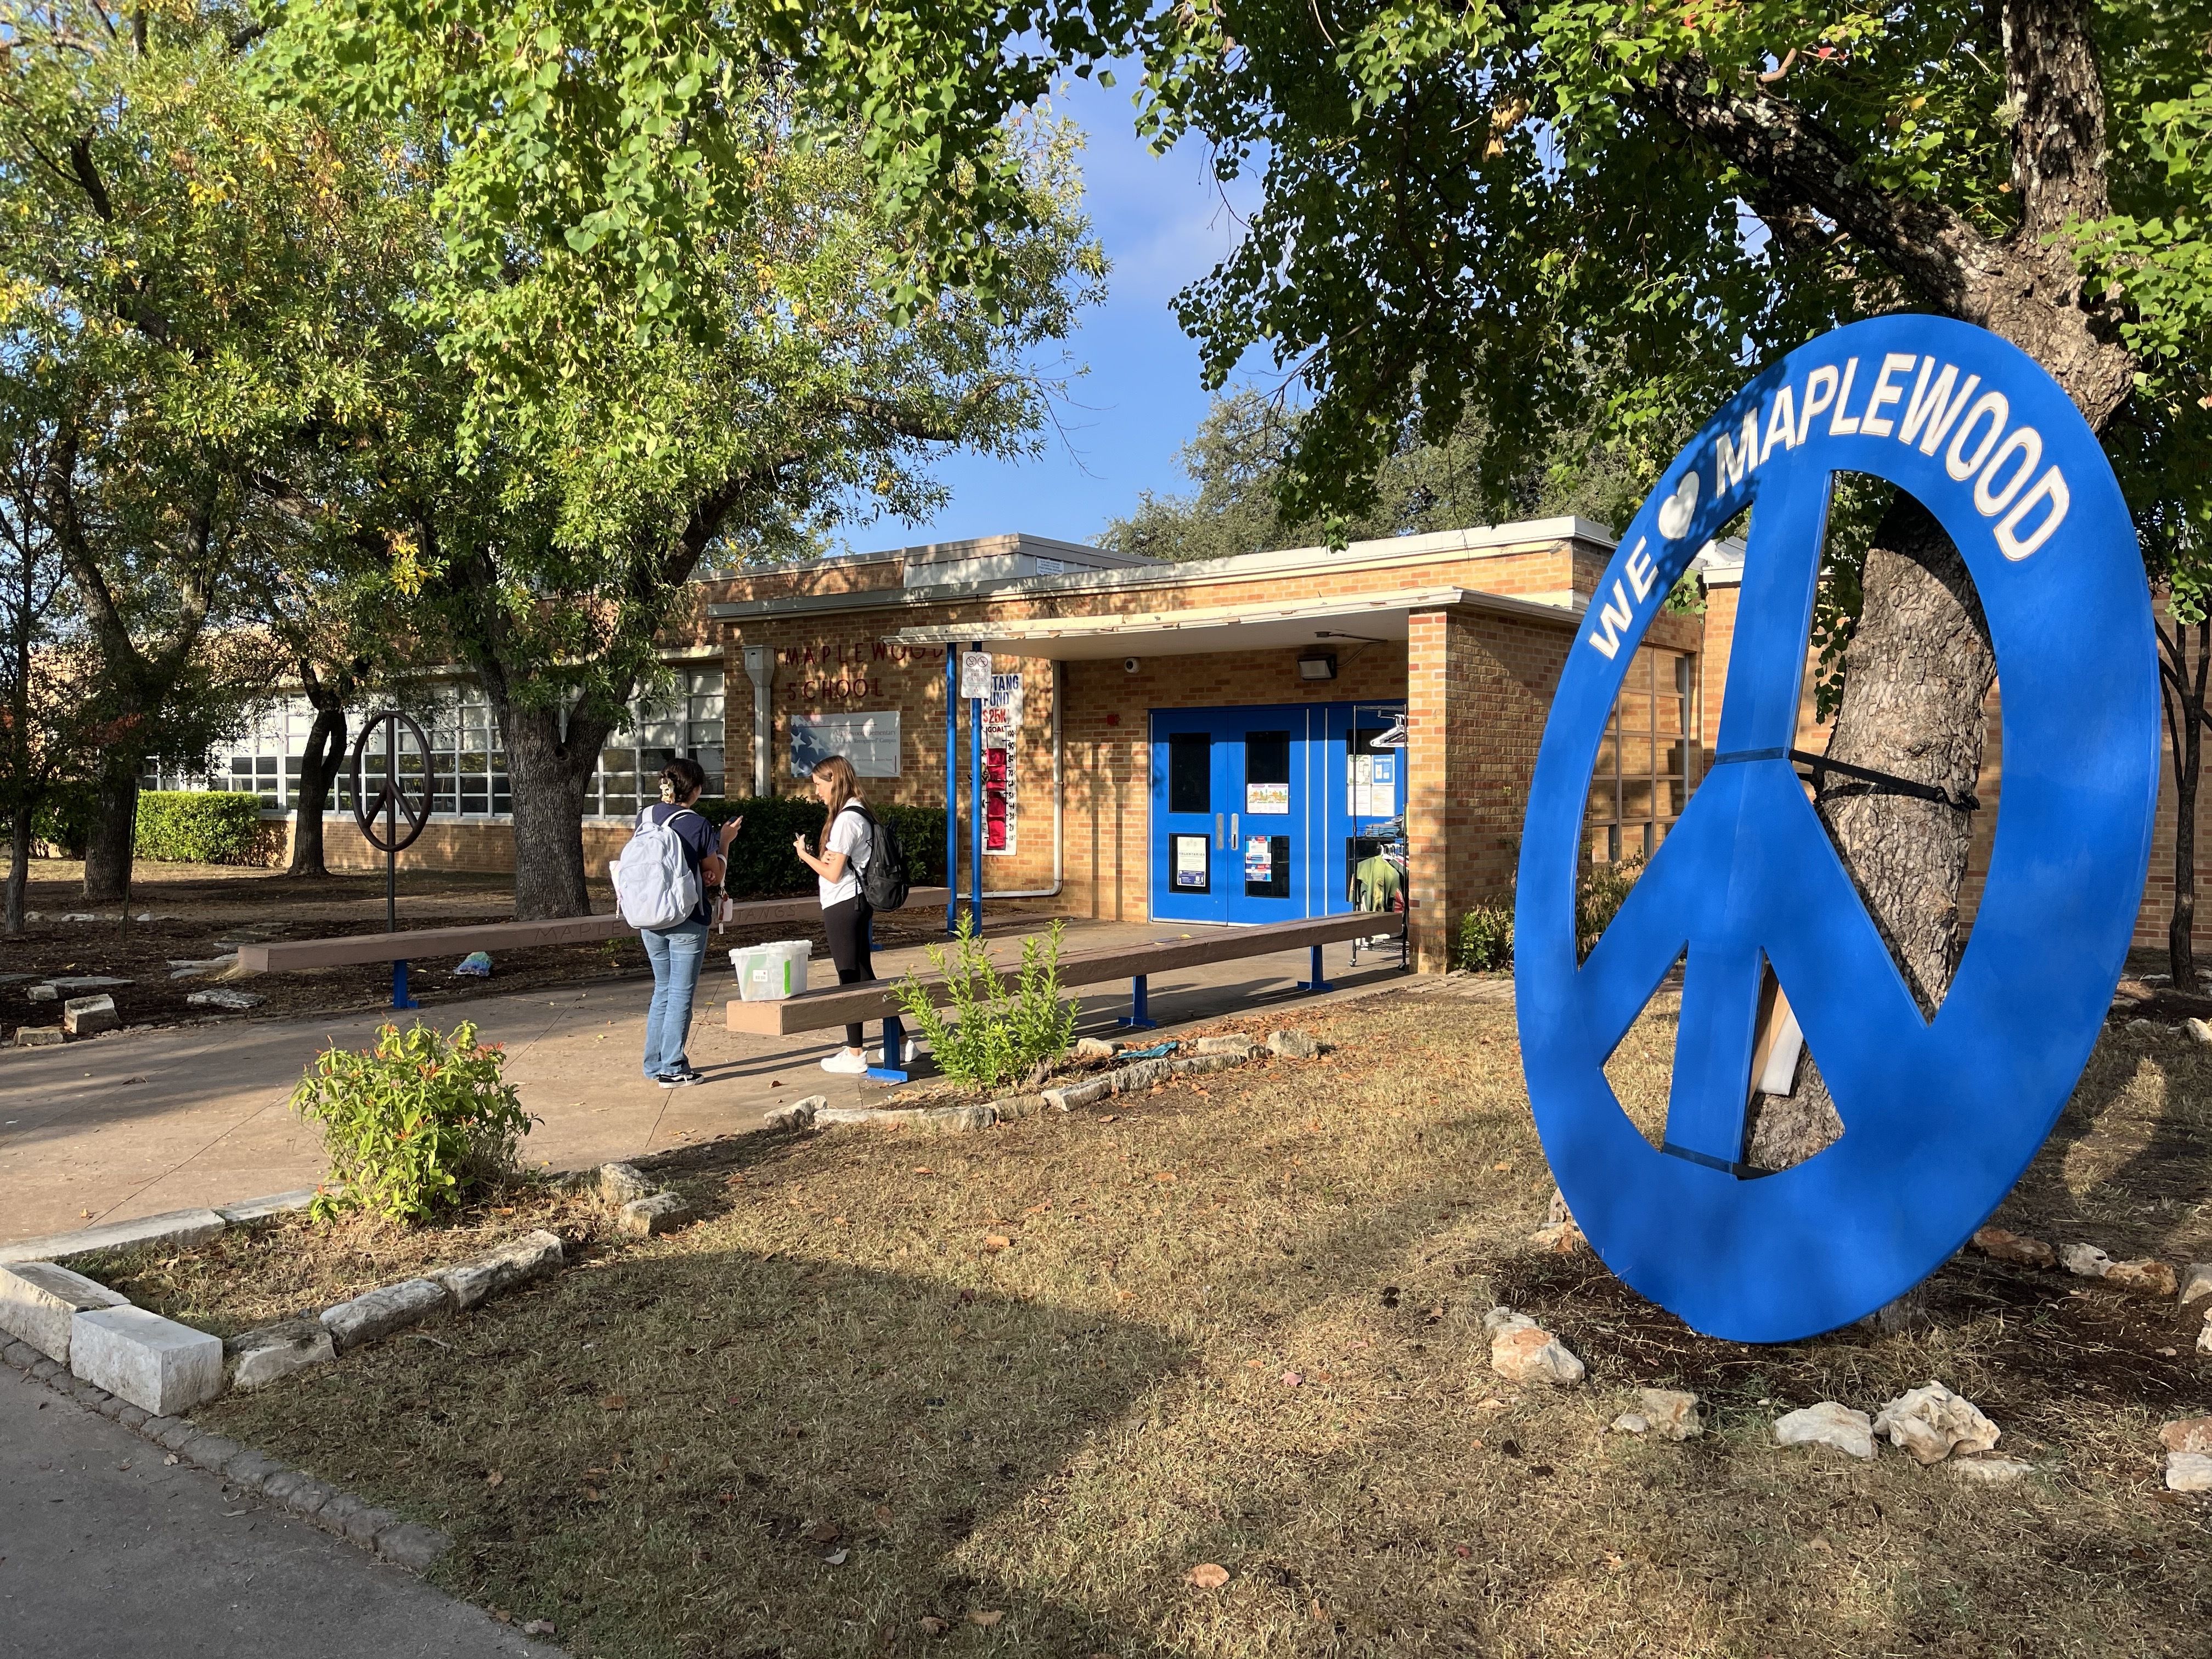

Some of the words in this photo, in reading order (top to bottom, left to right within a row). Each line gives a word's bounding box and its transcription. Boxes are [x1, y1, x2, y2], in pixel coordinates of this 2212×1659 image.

[1589, 535, 1659, 660] WE
[1715, 352, 2070, 562] MAPLEWOOD
[788, 678, 884, 701] SCHOOL
[992, 675, 1019, 691] TANG
[731, 904, 797, 923] TANGS
